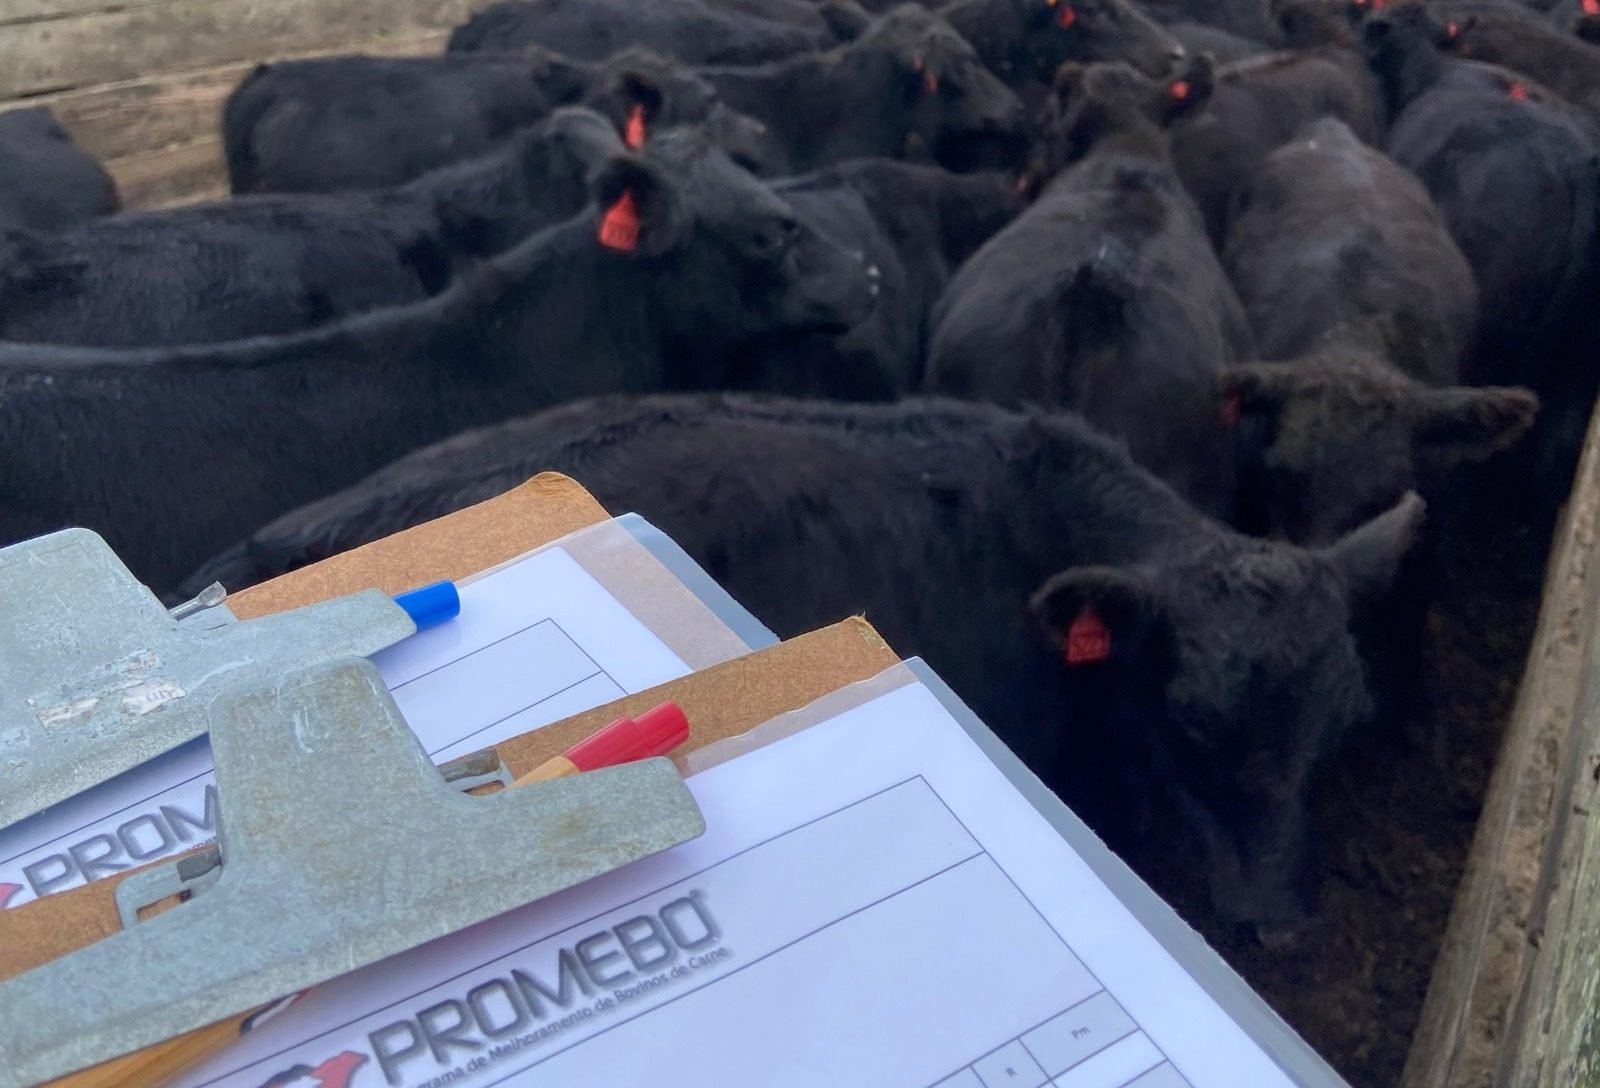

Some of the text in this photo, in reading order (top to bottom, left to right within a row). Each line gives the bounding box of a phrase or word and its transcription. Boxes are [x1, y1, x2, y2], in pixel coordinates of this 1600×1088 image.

[367, 896, 718, 1086] PROMEBO
[467, 1055, 487, 1072] de
[488, 1006, 593, 1061] Melhoramento
[595, 995, 614, 1012] de
[614, 972, 670, 1002] Bovinos
[670, 962, 688, 979] de
[689, 947, 729, 969] Carne
[1071, 1025, 1090, 1041] Pm
[1006, 1067, 1017, 1078] R
